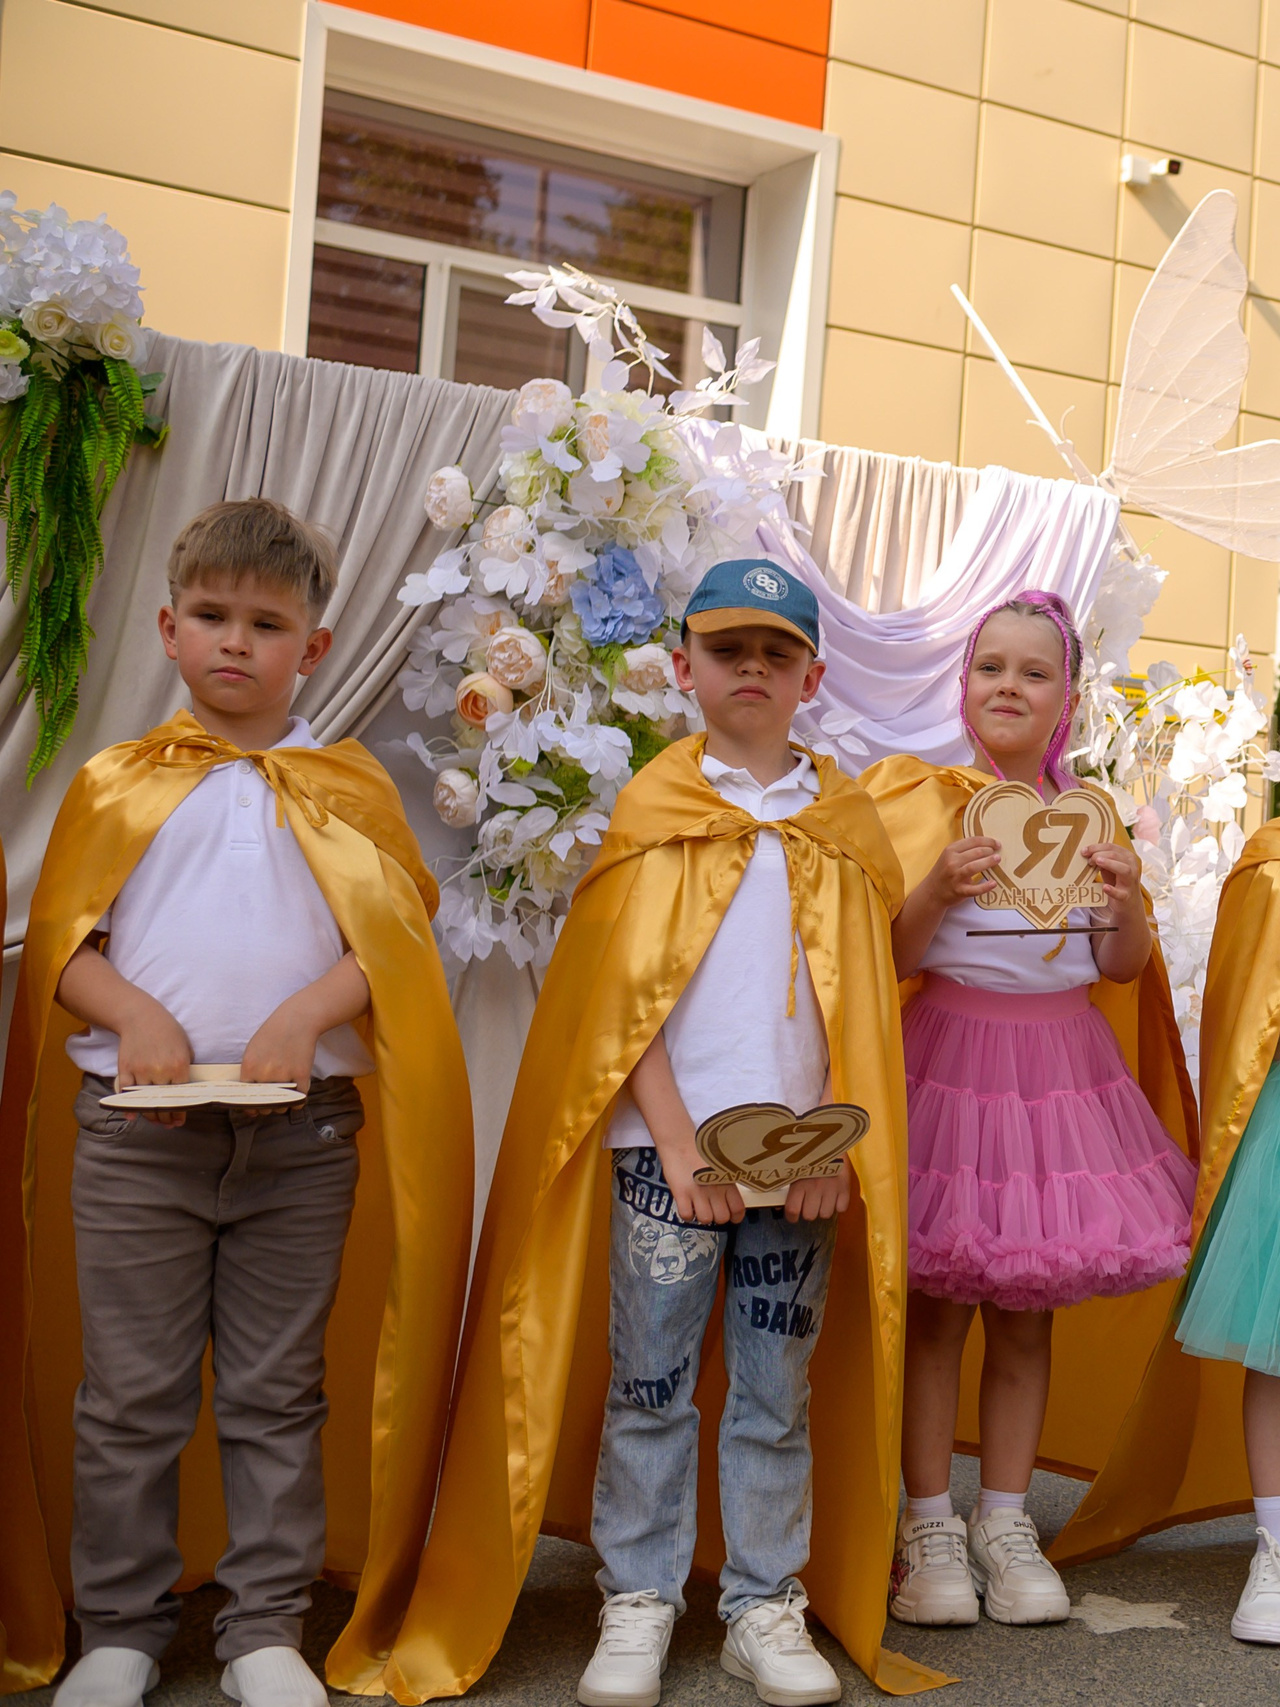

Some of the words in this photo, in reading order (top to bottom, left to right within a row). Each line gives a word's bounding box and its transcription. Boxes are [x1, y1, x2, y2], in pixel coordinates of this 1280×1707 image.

[978, 884, 1106, 906] ФАНТАЗЁРЫ
[697, 1164, 841, 1183] ФАНТАЗЁРЫ
[733, 1249, 800, 1288] ROCK
[751, 1296, 814, 1339] BAND
[912, 1522, 944, 1534] SHUZZI
